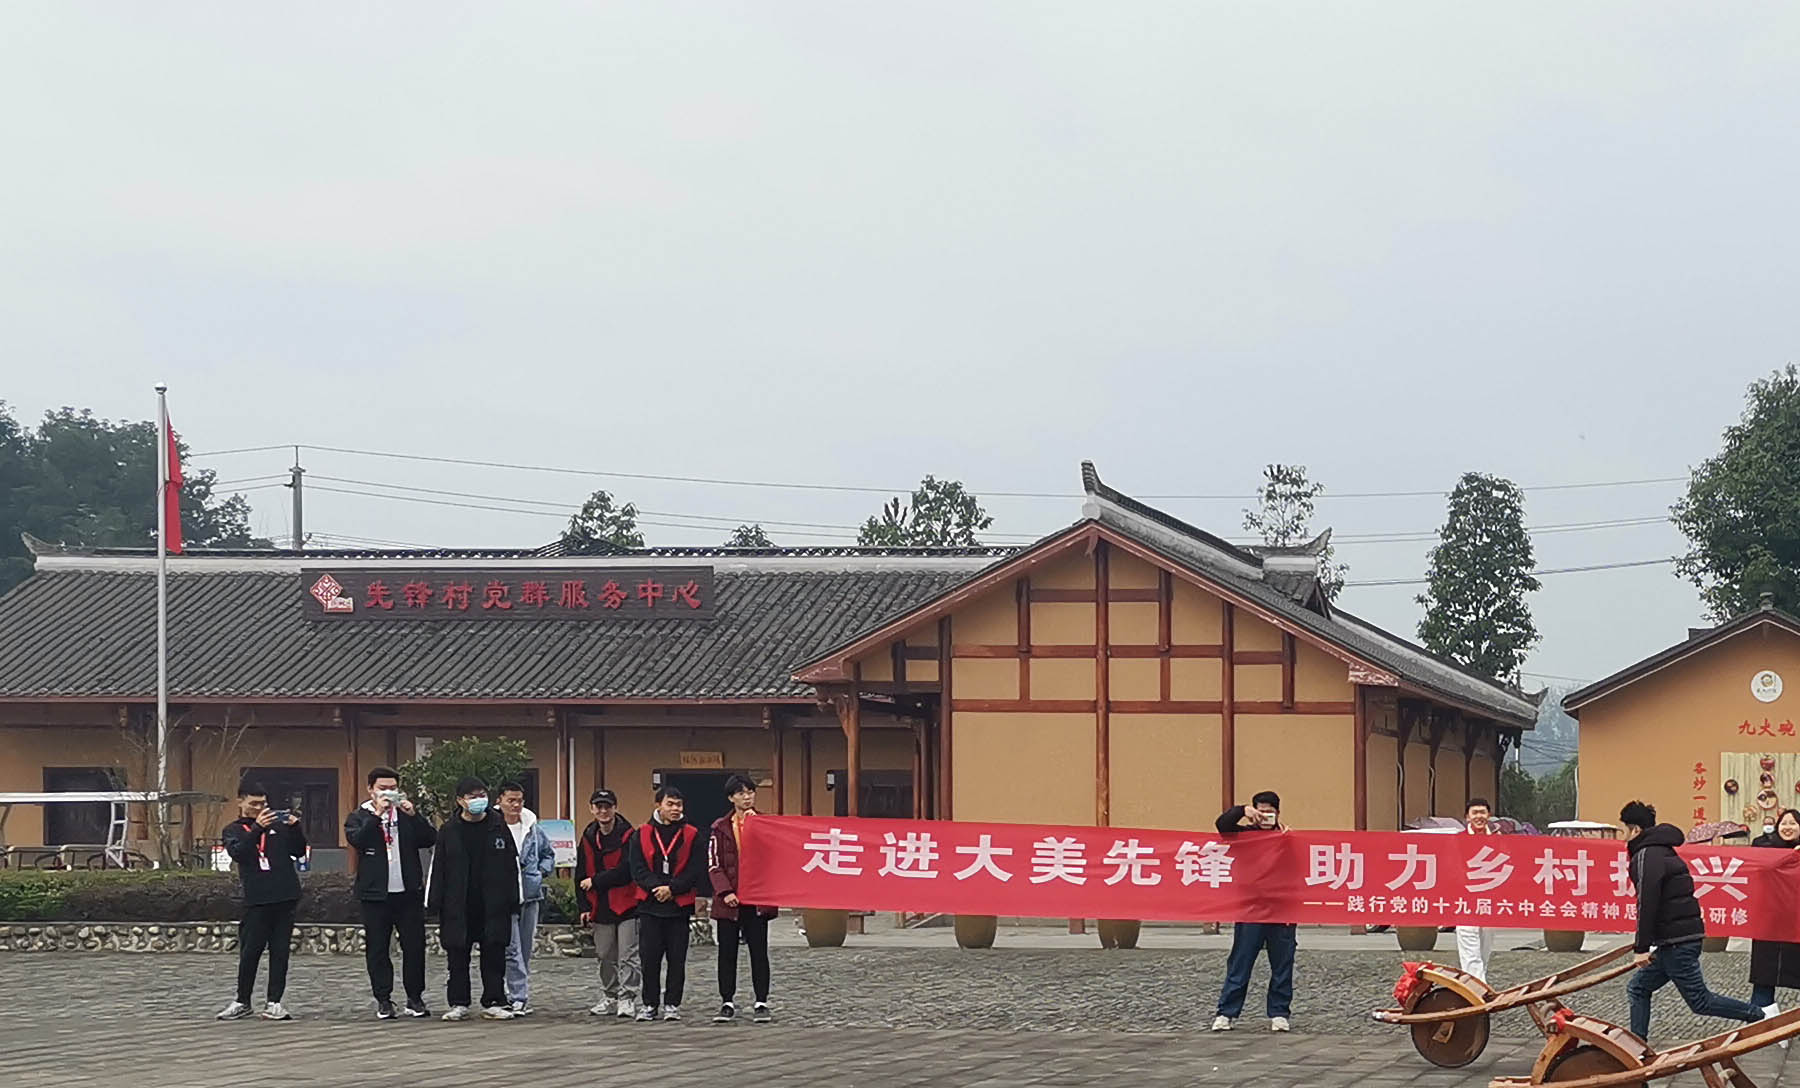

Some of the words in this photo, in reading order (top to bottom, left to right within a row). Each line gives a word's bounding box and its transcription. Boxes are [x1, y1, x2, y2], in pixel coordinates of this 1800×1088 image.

[365, 579, 702, 611] 先锋村党群服务中心
[1738, 718, 1796, 737] 九大碗
[802, 828, 1236, 889] 走进大美先锋
